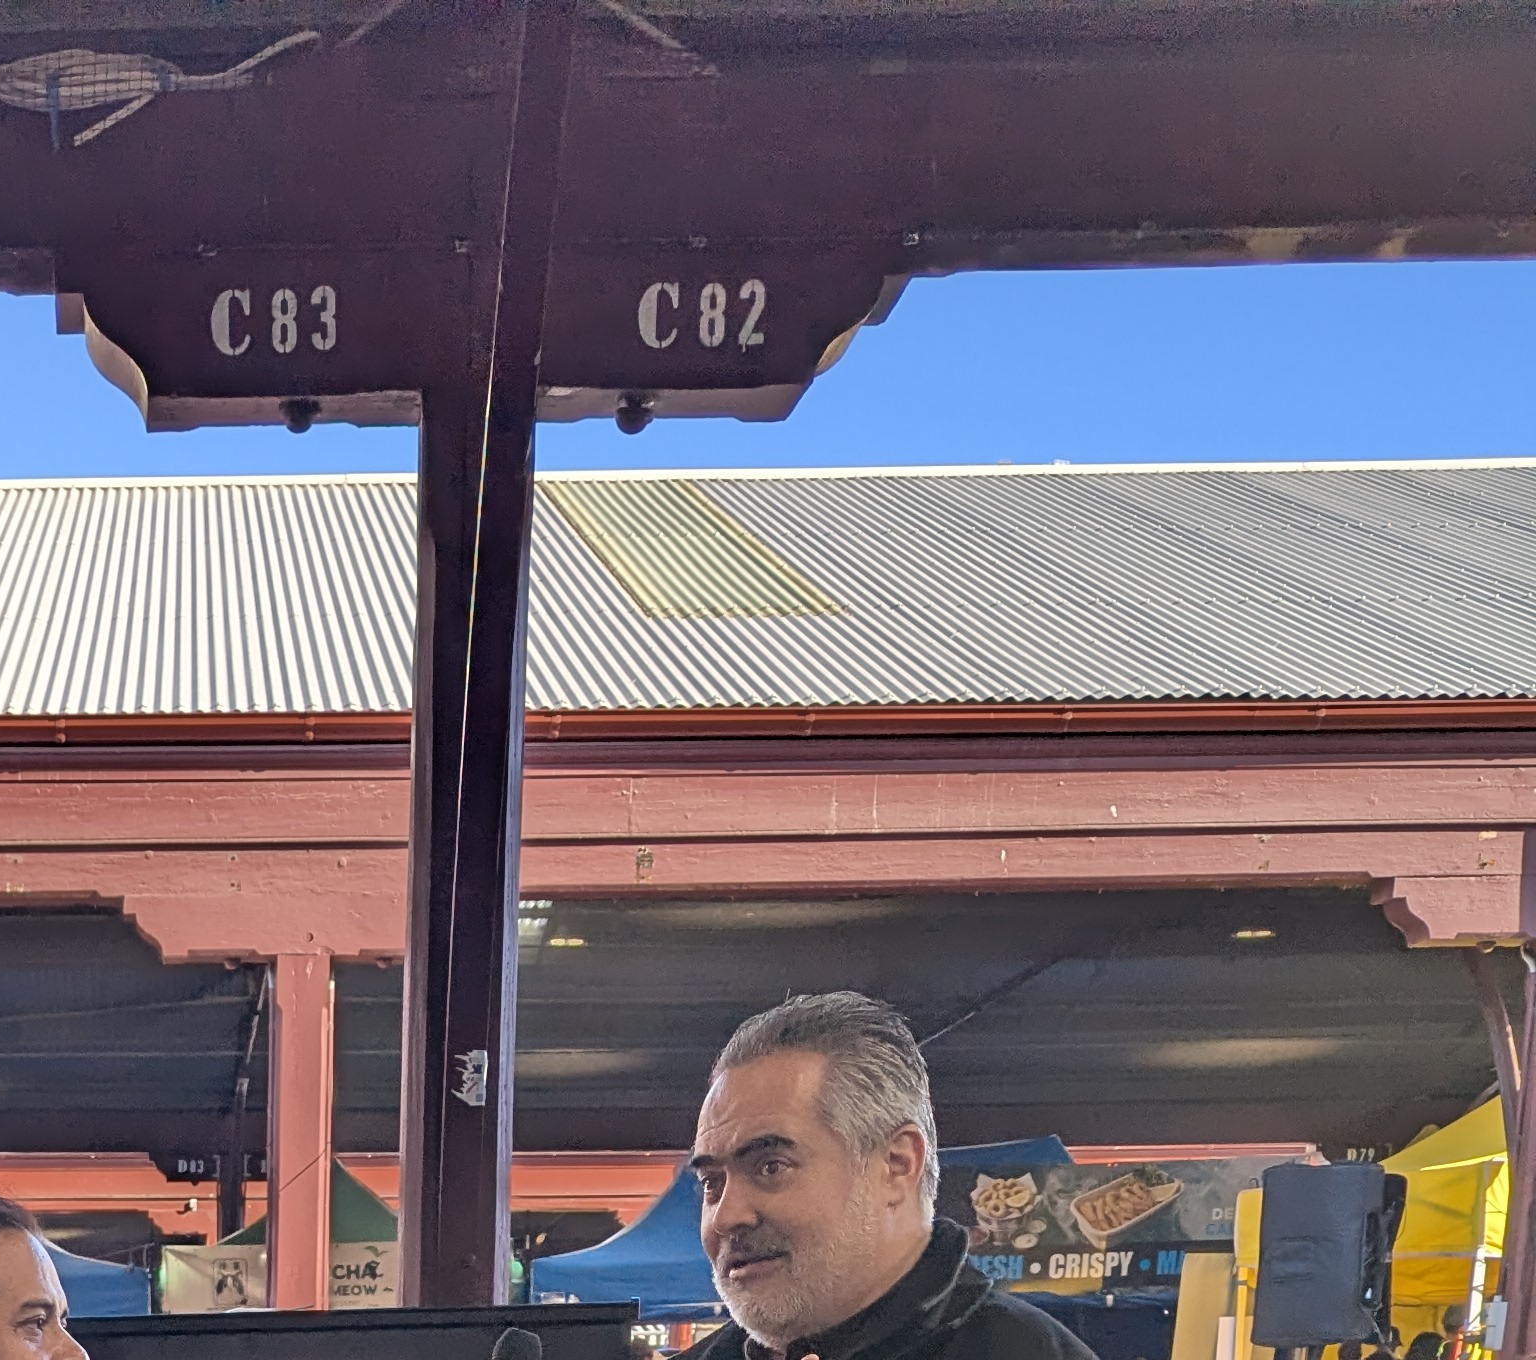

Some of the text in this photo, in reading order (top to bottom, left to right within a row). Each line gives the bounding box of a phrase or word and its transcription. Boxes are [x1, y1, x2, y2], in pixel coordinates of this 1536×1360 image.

[211, 285, 339, 356] C 83
[637, 278, 768, 350] C 82
[1048, 1251, 1134, 1279] CRISPY
